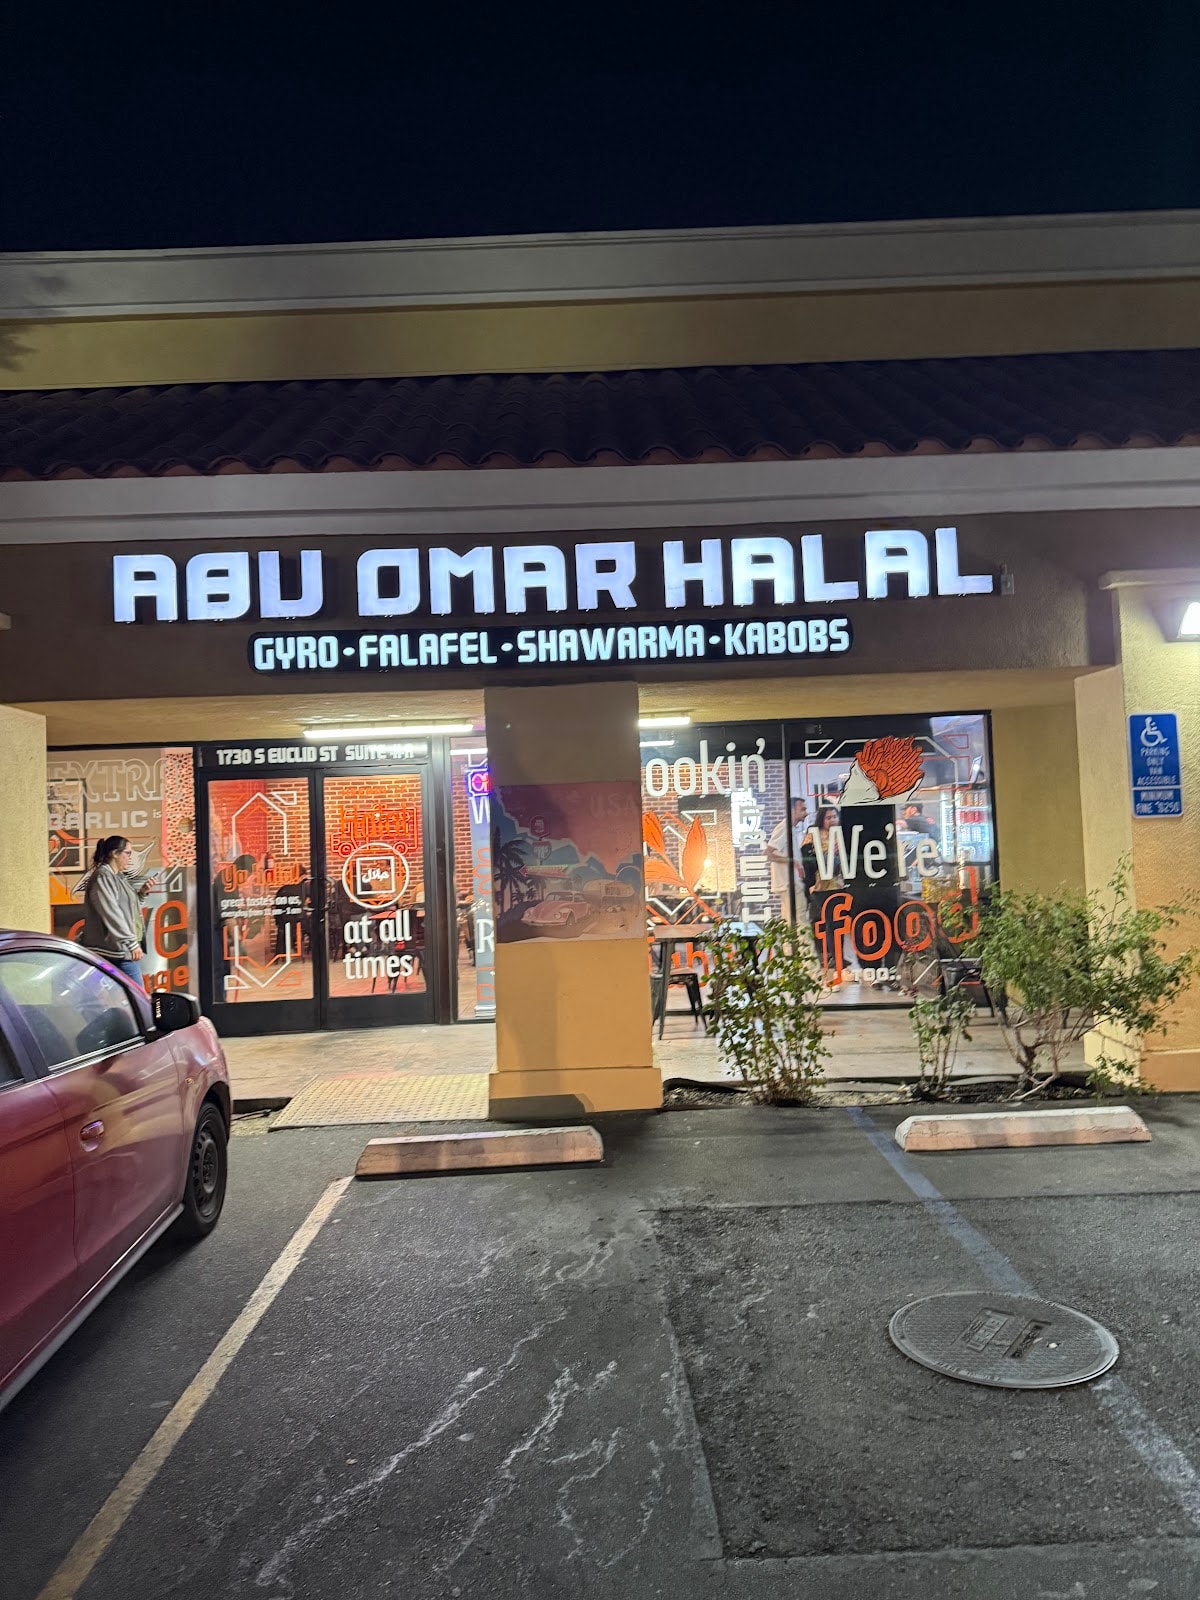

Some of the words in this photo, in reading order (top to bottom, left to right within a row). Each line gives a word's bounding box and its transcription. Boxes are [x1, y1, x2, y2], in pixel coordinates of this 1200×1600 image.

[113, 550, 323, 622] ABU
[357, 543, 637, 617] OMAR
[662, 527, 993, 609] HALAL
[253, 635, 338, 671] GYRO
[358, 631, 497, 667] FALAFEL
[517, 624, 705, 663] SHAWARMA
[724, 618, 850, 656] KABOBS
[216, 749, 251, 765] 1730
[254, 748, 265, 764] S
[267, 746, 317, 764] EUCLID
[319, 745, 338, 762] ST
[345, 744, 386, 761] SUITE
[645, 737, 767, 797] ookin'
[808, 822, 940, 881] We're
[343, 915, 372, 944] at
[379, 909, 412, 942] all
[814, 892, 979, 987] food
[343, 952, 414, 980] times
